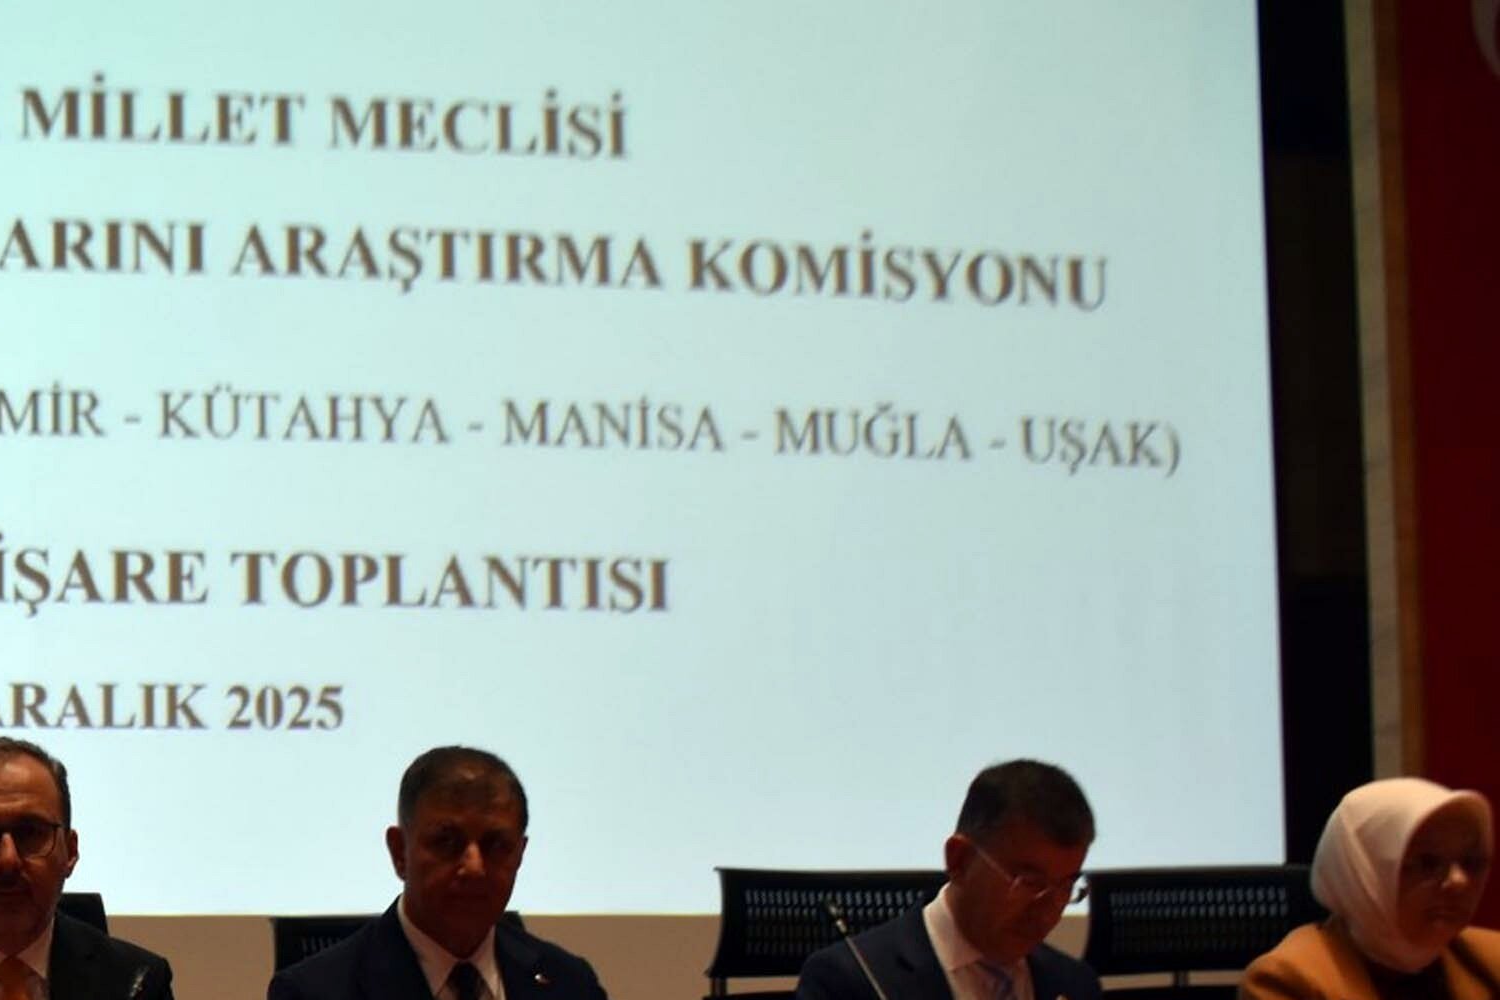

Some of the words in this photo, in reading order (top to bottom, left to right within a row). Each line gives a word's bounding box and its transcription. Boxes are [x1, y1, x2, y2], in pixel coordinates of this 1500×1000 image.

[22, 73, 305, 145] MİLLET
[331, 89, 625, 158] MECLİSİ
[233, 224, 662, 293] ARAŞTIRMA
[690, 231, 1110, 309] KOMİSYONU
[160, 384, 450, 444] KÜTAHYA
[504, 396, 724, 451] MANİSA
[775, 403, 971, 460] MUĞLA
[1021, 418, 1181, 478] UŞAK)
[230, 552, 668, 613] TOPLANTISI
[227, 685, 344, 730] 2025
